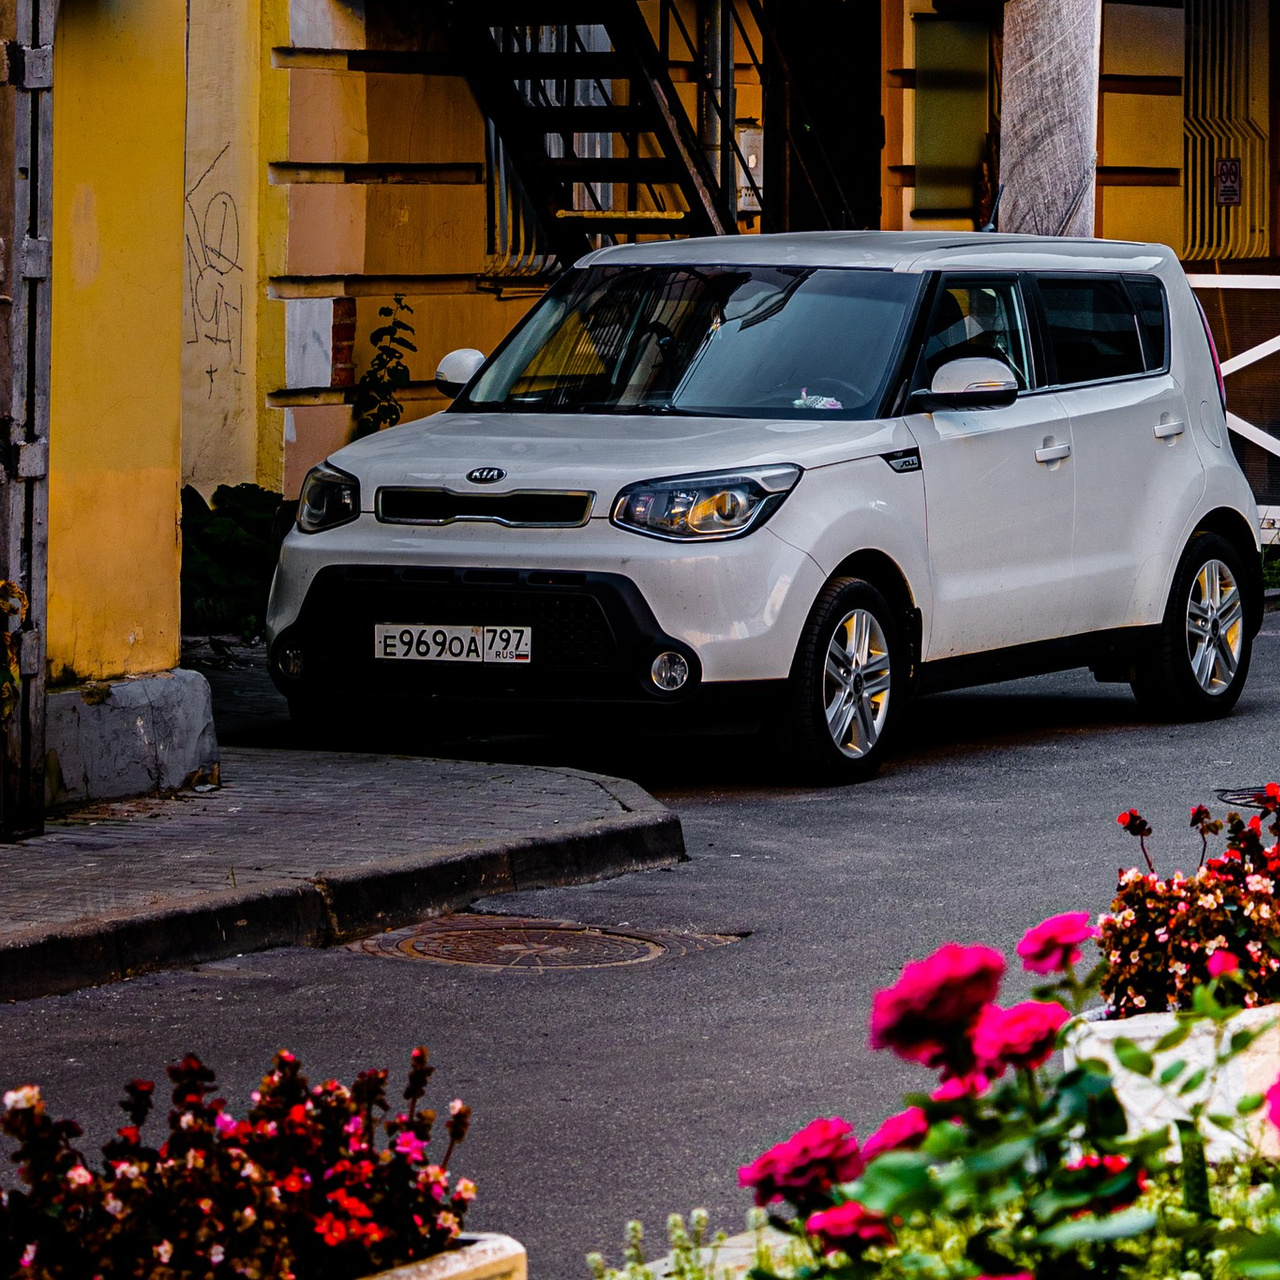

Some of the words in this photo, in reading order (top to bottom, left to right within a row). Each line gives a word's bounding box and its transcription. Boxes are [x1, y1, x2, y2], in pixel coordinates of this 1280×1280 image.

[471, 469, 498, 479] KIA
[383, 628, 481, 658] Е969ОА
[486, 629, 525, 651] 797
[495, 651, 515, 660] RUS
